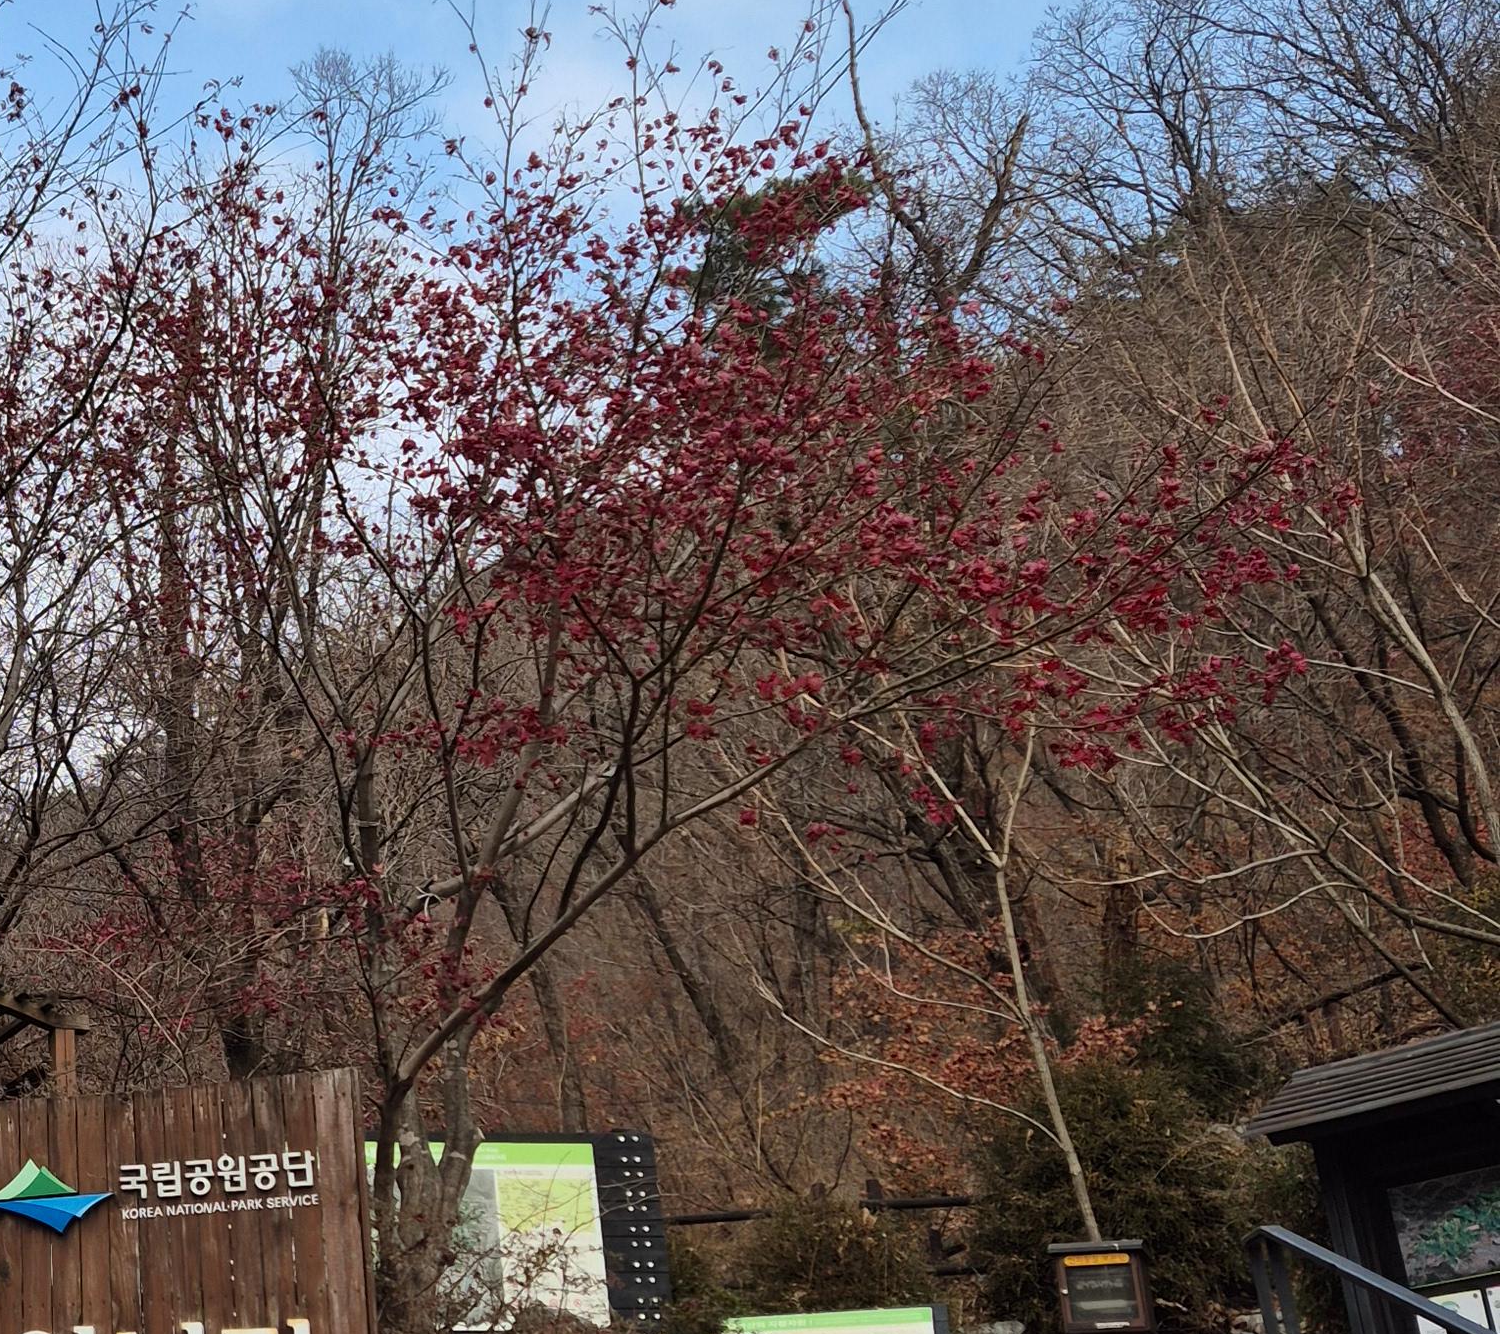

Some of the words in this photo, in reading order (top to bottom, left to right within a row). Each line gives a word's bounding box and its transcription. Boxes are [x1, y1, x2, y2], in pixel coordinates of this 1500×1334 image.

[119, 1150, 315, 1199] 국립공원공단
[122, 1206, 163, 1220] KOREA
[166, 1202, 228, 1217] NATIONAL
[230, 1198, 263, 1212] PARK
[266, 1193, 319, 1209] SERVICE
